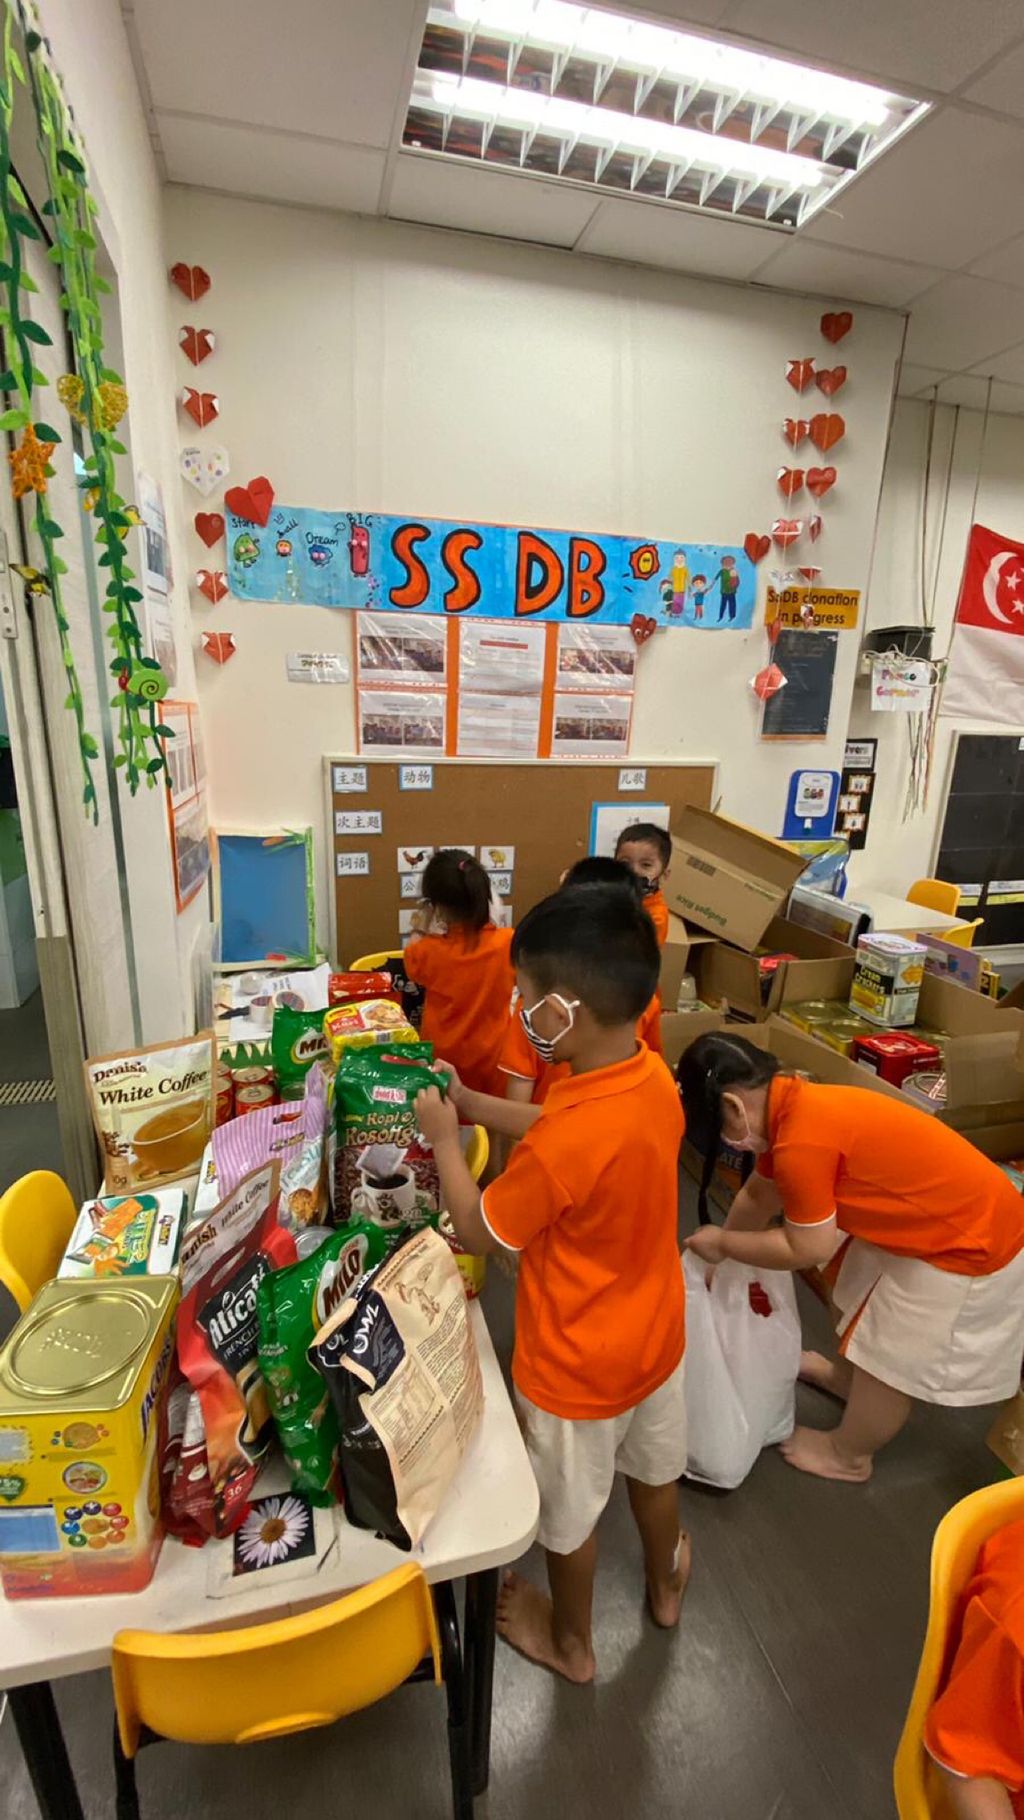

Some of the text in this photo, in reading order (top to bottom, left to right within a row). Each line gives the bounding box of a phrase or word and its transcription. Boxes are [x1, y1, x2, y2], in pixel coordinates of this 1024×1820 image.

[305, 532, 338, 546] Dream
[346, 513, 372, 527] BIG
[802, 593, 858, 606] donation
[792, 613, 845, 626] pgress
[337, 771, 364, 786] 主题
[403, 770, 430, 784] 动物
[337, 815, 380, 829] 次主题
[340, 857, 366, 869] 词语
[99, 1071, 208, 1105] White Coffee
[244, 1179, 269, 1205] Coffee
[322, 1247, 361, 1317] MILO
